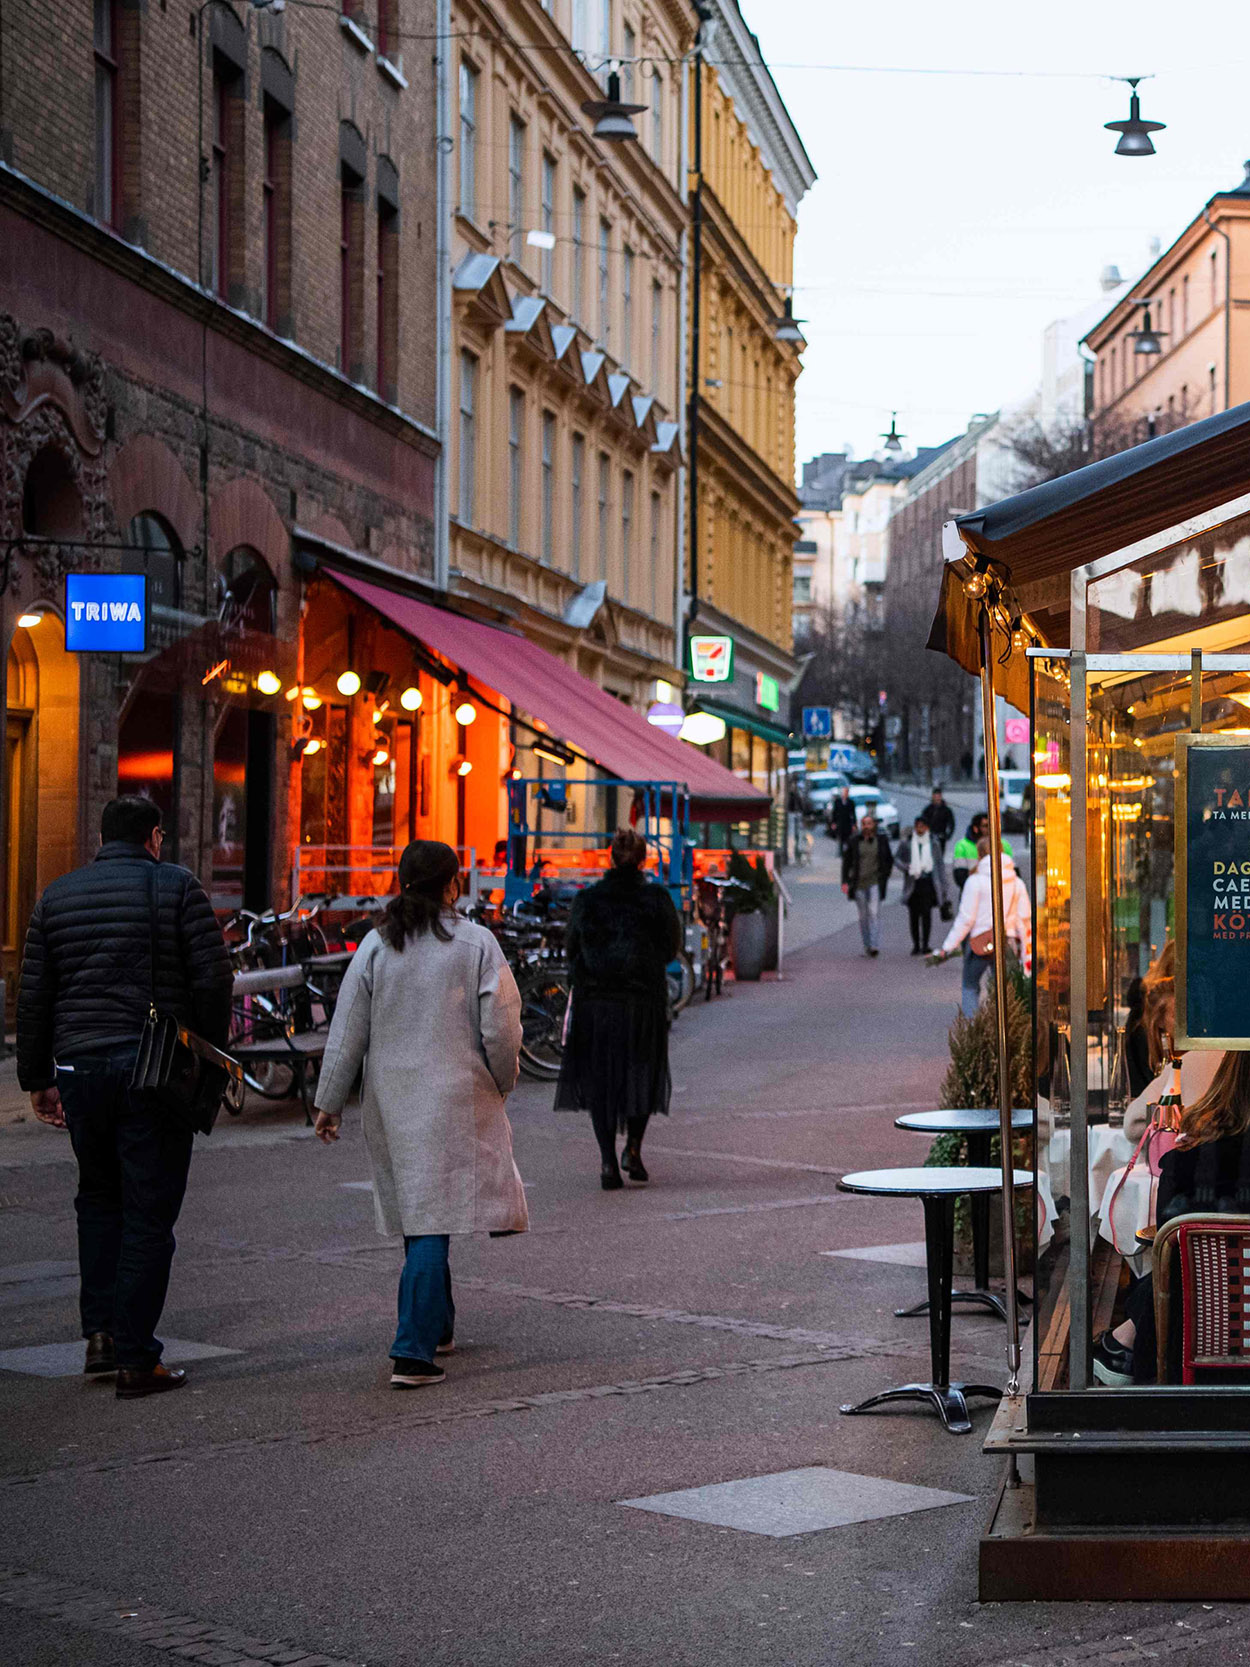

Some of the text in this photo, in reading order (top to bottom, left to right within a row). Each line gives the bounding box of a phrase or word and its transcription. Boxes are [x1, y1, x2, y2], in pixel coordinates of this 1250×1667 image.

[71, 602, 142, 621] TRIWA
[1213, 811, 1226, 820] TA
[1213, 932, 1236, 940] MED
